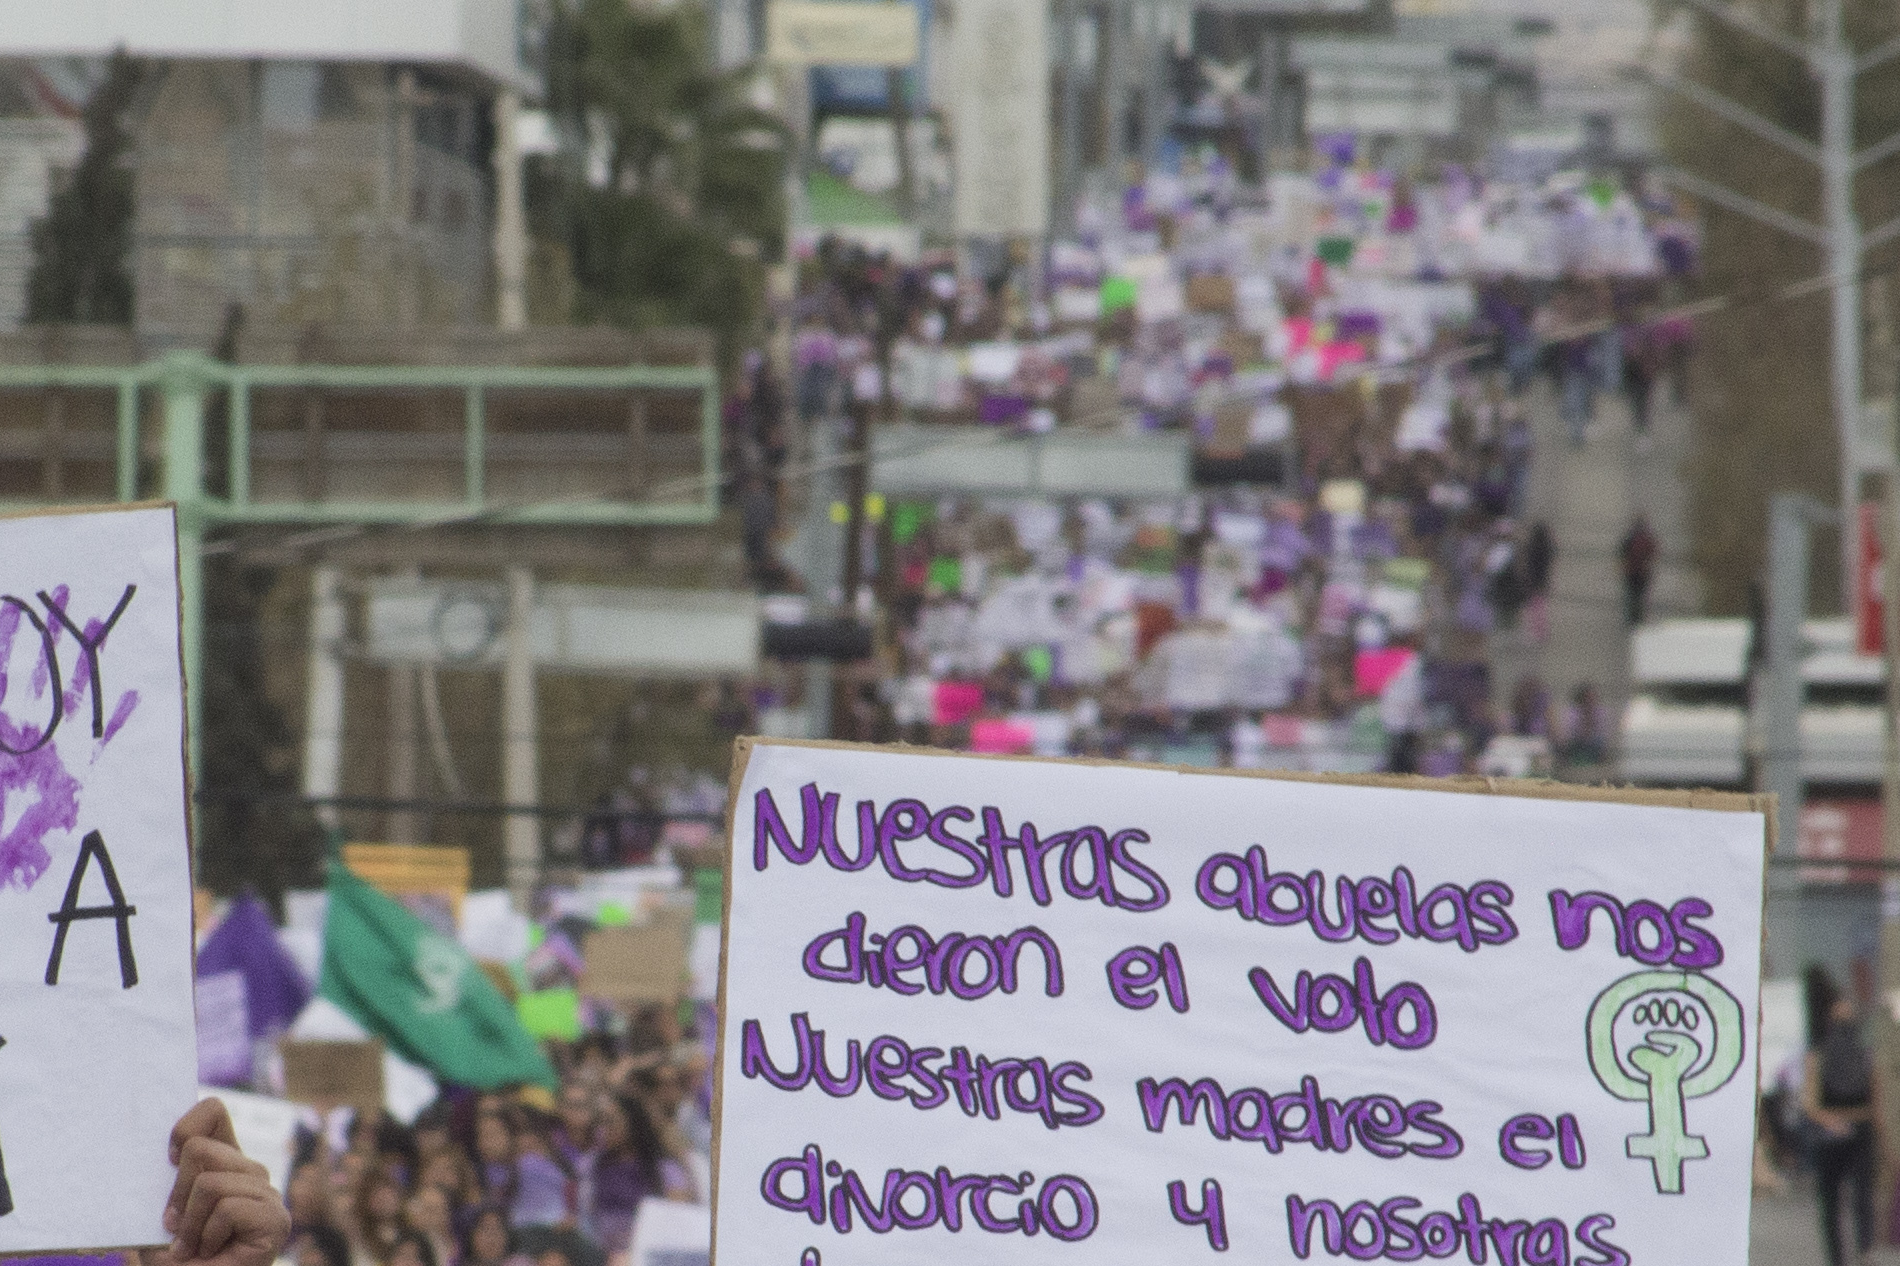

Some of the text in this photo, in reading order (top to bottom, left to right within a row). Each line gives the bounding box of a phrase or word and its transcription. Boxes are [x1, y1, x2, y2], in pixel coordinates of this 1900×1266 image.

[45, 830, 139, 989] A
[754, 782, 1724, 968] Nuestras abuelas nos
[802, 911, 1438, 1050] dieron el voto
[742, 1012, 1586, 1169] Nuestras madres el
[761, 1144, 1099, 1241] divorcio
